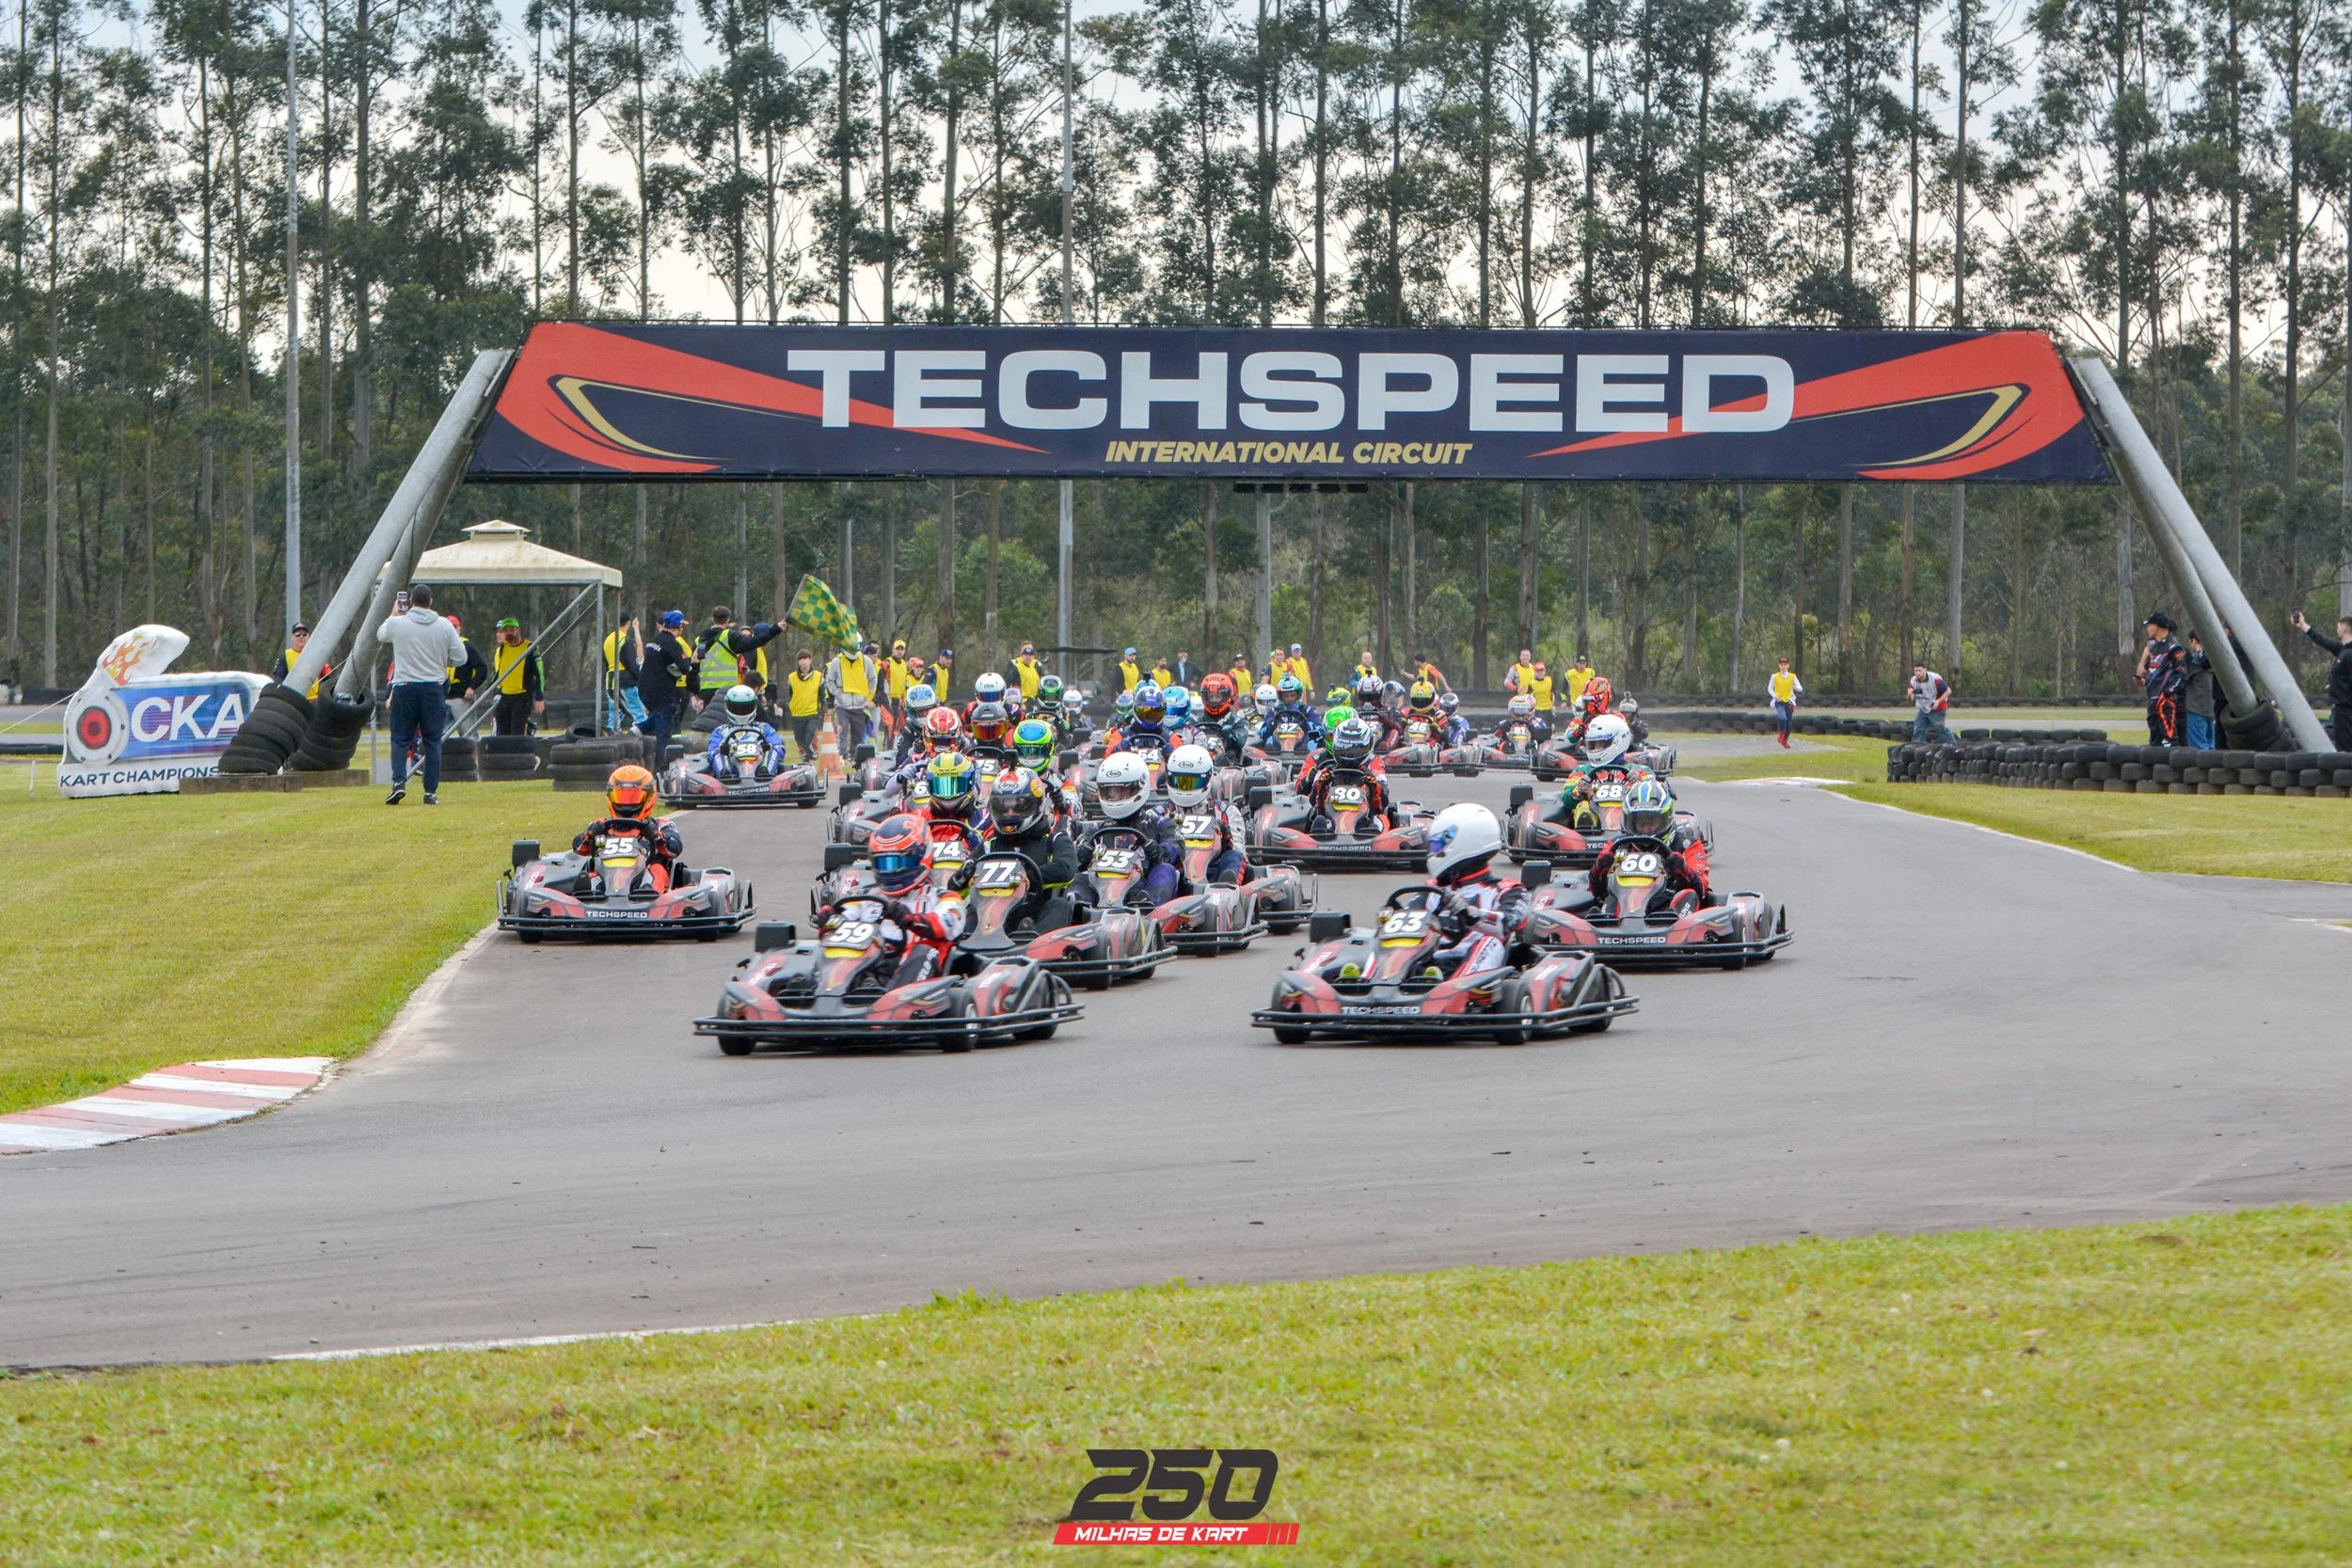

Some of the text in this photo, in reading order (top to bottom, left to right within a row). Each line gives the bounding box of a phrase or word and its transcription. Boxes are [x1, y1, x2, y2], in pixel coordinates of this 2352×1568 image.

[787, 349, 1795, 433] TECHSPEED
[1104, 441, 1473, 465] INTERNATIONAL CIRCUIT
[737, 743, 756, 753] 58
[60, 772, 110, 787] KART
[1597, 784, 1623, 798] 68
[1180, 815, 1213, 834] 57
[603, 837, 633, 854] 55
[932, 841, 960, 858] 74
[1097, 849, 1135, 867] 53
[1621, 854, 1657, 872] 60
[979, 862, 1016, 882] 77
[1384, 911, 1428, 933] 63
[829, 922, 875, 943] 59
[1341, 1006, 1421, 1015] TECHSPEED
